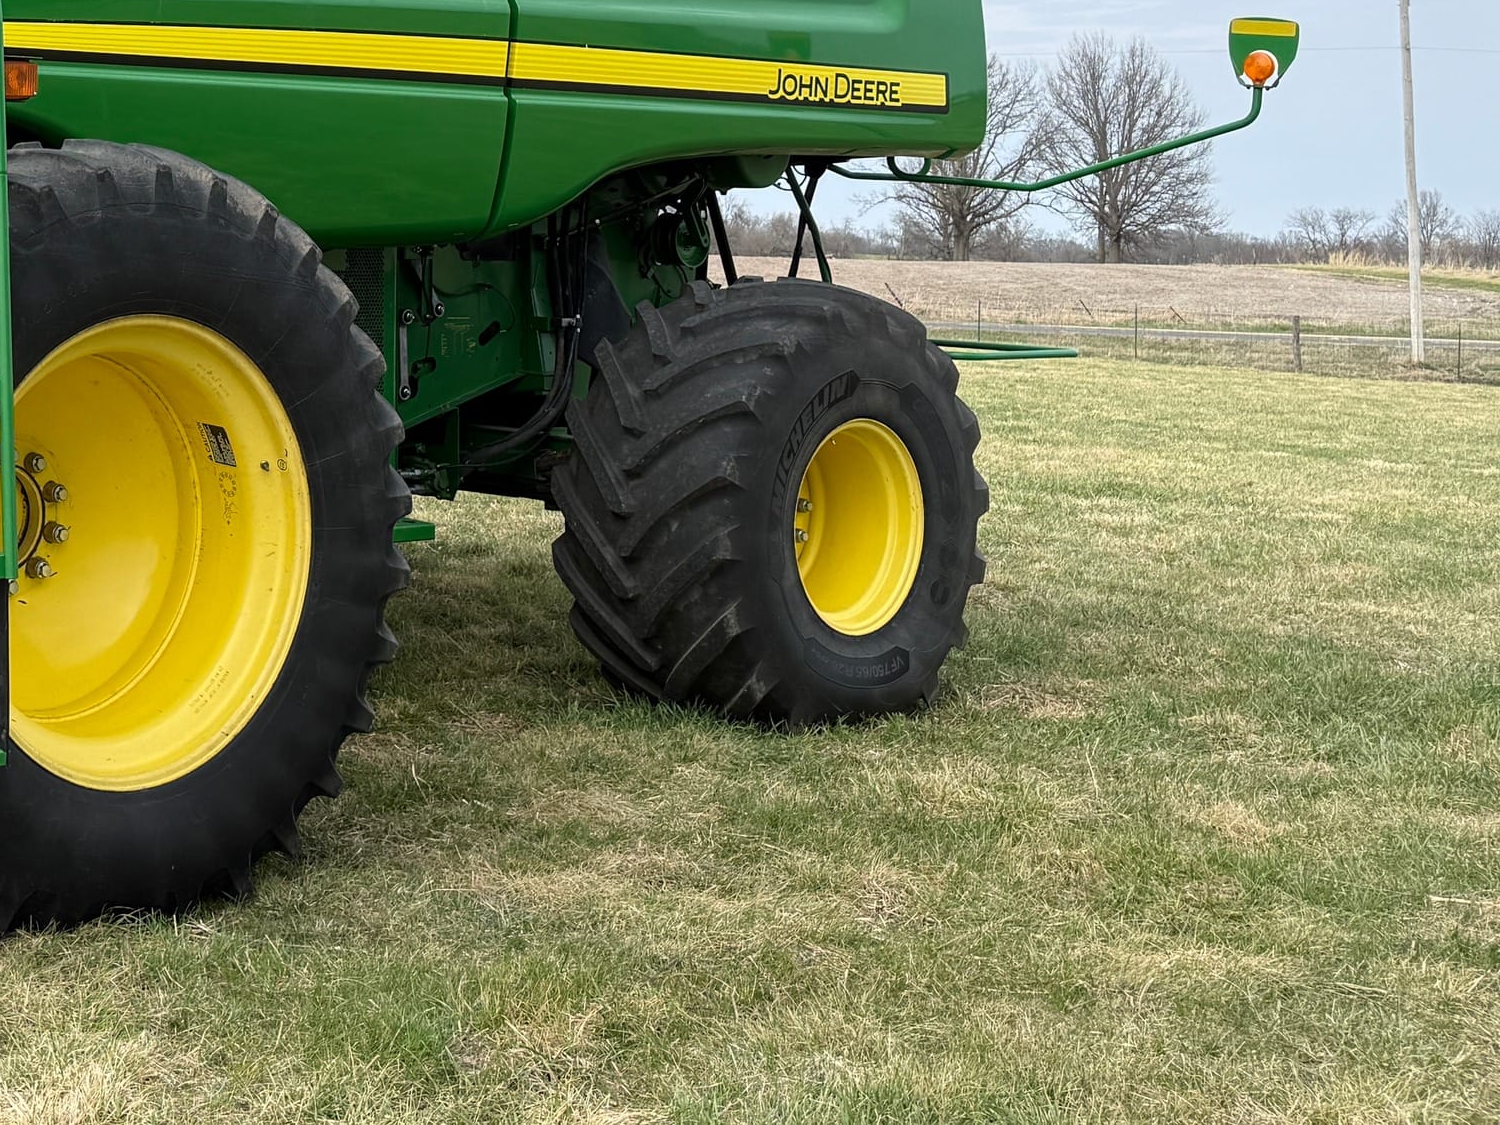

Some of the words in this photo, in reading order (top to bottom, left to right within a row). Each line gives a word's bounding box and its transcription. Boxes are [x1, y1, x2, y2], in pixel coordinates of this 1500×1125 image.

[768, 68, 829, 98] JOHN
[834, 72, 901, 103] DEERE
[771, 373, 851, 516] MICHELIN
